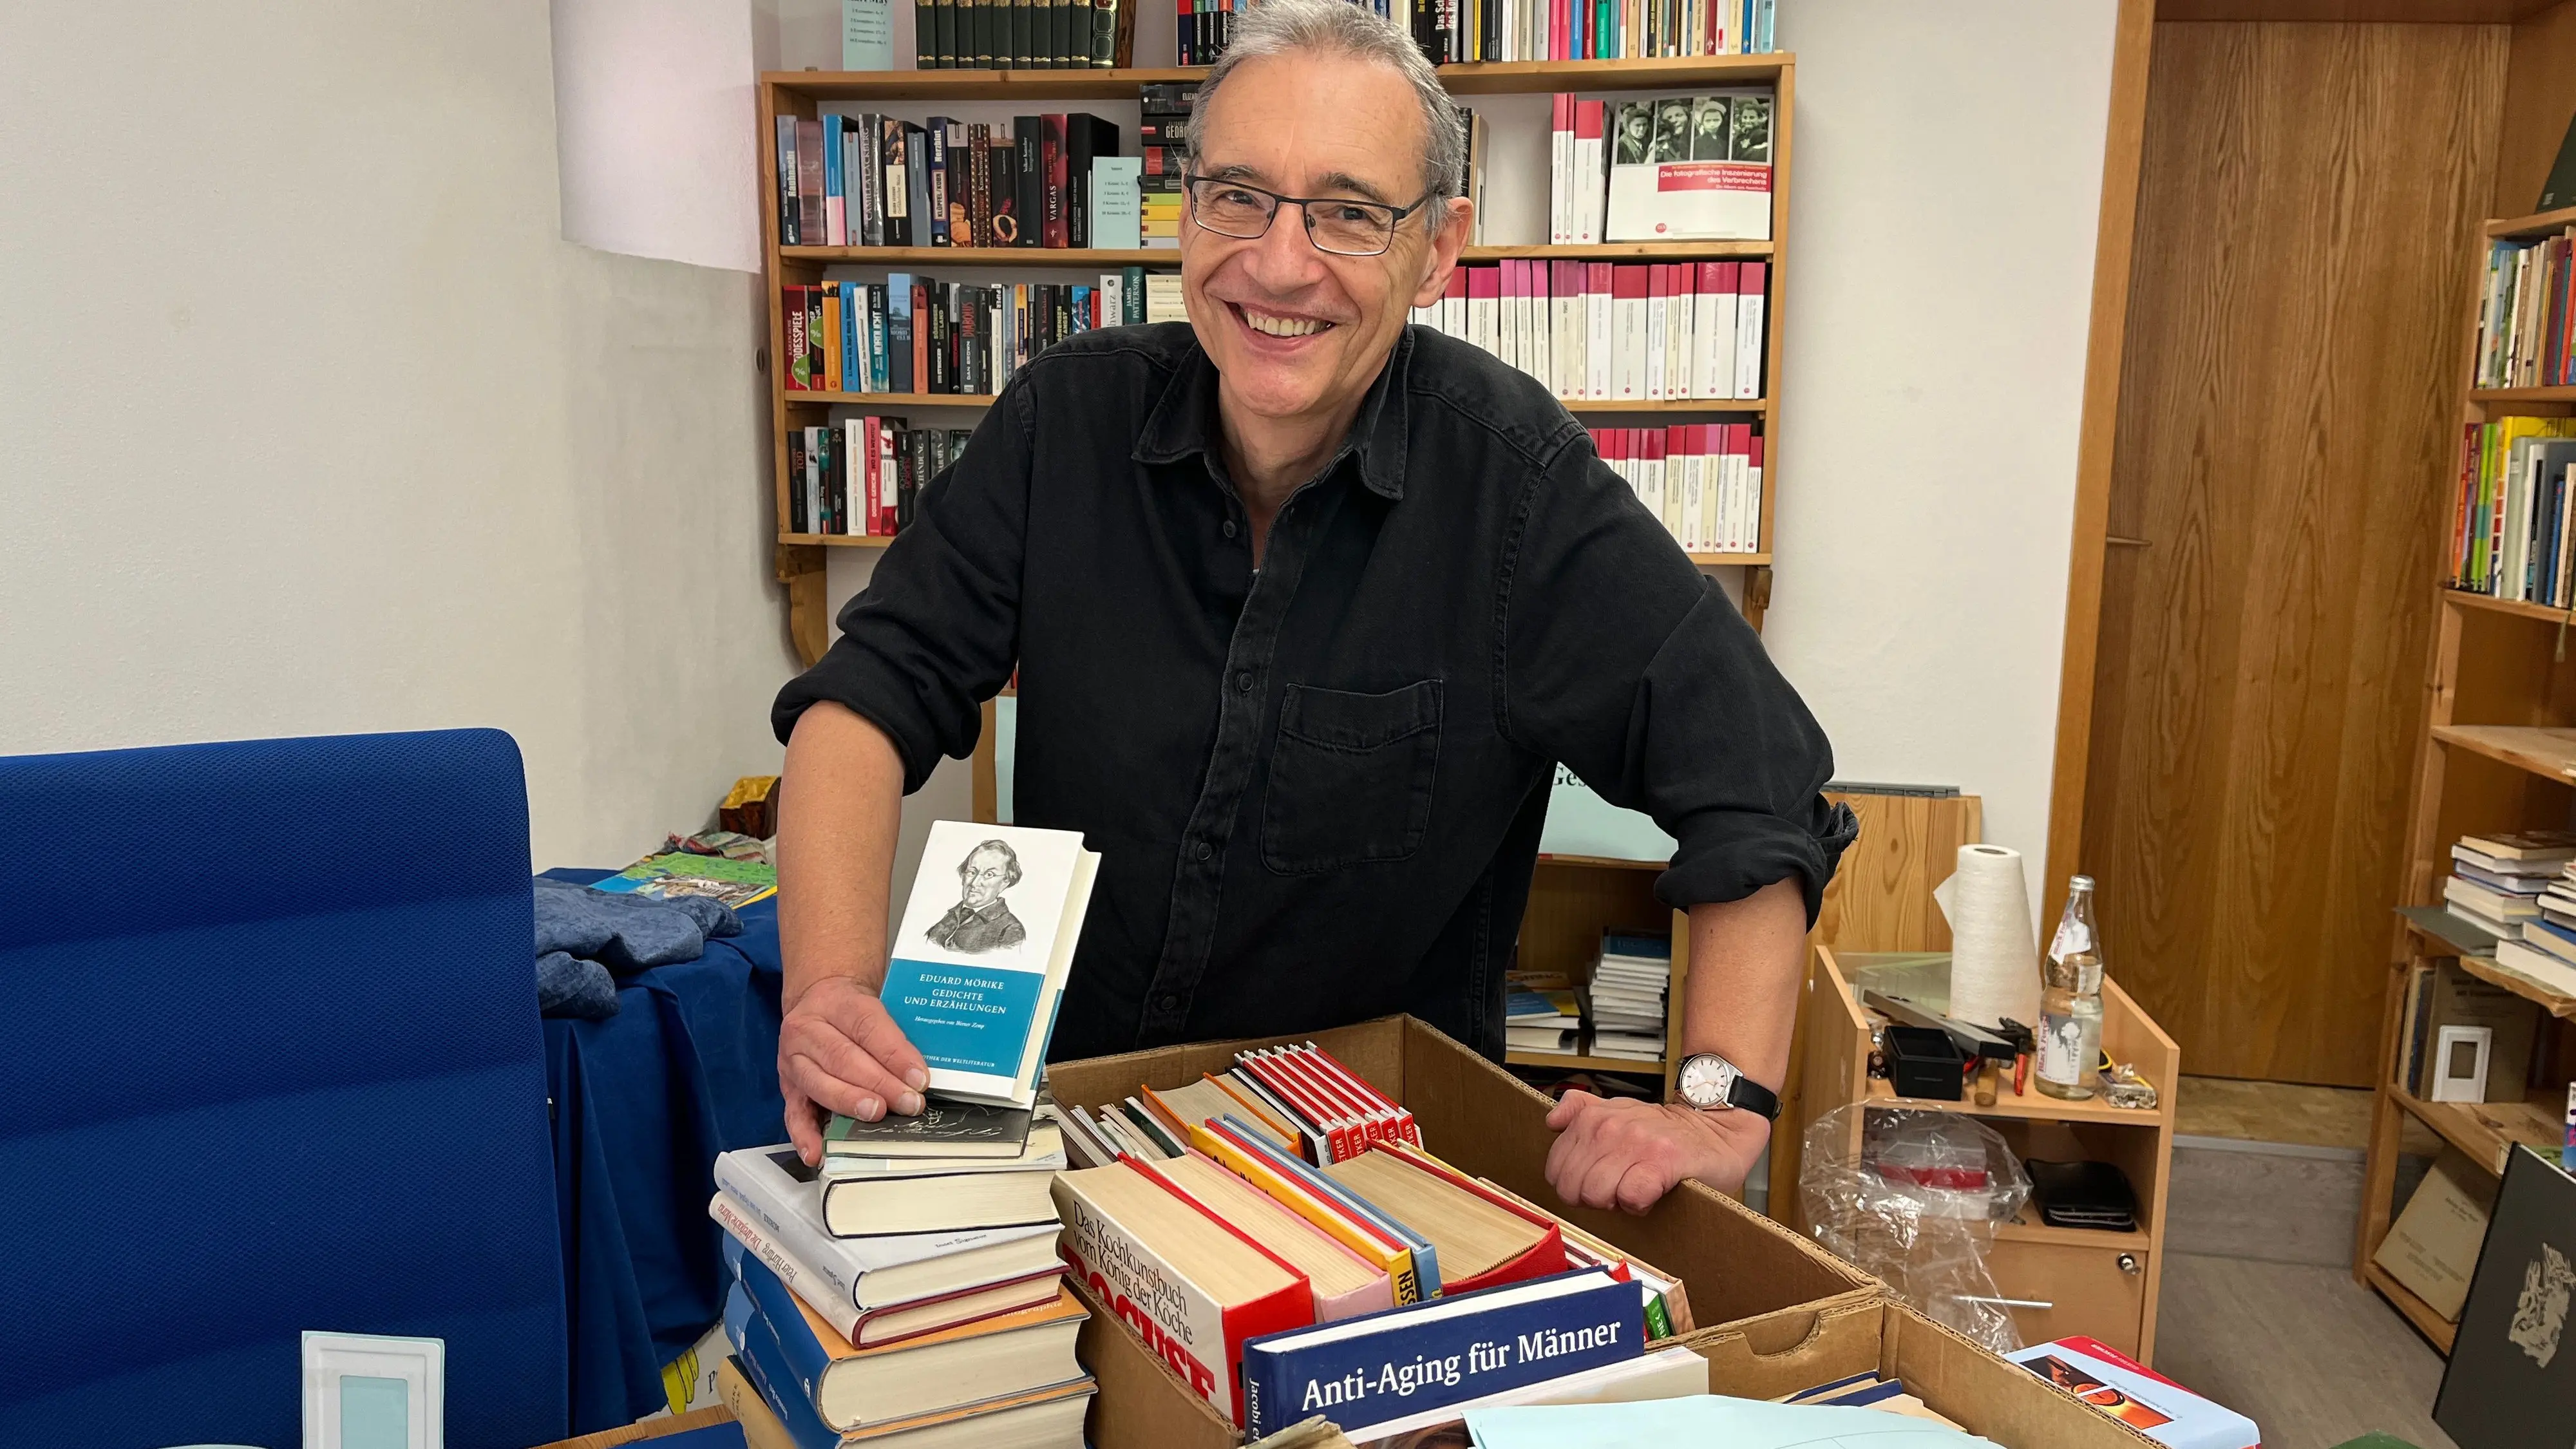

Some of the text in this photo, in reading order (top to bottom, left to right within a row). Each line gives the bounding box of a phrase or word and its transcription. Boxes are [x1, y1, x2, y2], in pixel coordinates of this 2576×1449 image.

[1435, 0, 1445, 30] Das Sc
[1446, 0, 1456, 30] des Ko
[1166, 126, 1188, 138] GEORG
[934, 129, 942, 162] Herzblut
[786, 150, 797, 196] Rauhnacht
[962, 302, 974, 337] DIABOLUS
[873, 311, 883, 355] NORDLICHT
[1553, 766, 1586, 787] Ge
[919, 974, 1005, 990] EDUARD MÖRIKE
[904, 996, 1007, 1014] UND ERZÄHLUNGEN
[932, 989, 984, 1001] GEDICHTE
[914, 1016, 945, 1025] Herausgegeben
[952, 1058, 995, 1067] WELTLITERATUR
[1354, 1133, 1364, 1155] TKER
[1370, 1126, 1379, 1142] KER
[1406, 1123, 1416, 1146] TKER
[1336, 1137, 1347, 1162] ETKER
[717, 1203, 733, 1226] Maria
[729, 1215, 753, 1241] dreifache
[762, 1243, 784, 1271] Härtling
[1074, 1200, 1188, 1317] Das Kochkunstbuch
[781, 1264, 797, 1284] Peter
[1074, 1230, 1193, 1345] vom König der Köche
[1397, 1269, 1416, 1306] SSEN
[1003, 1302, 1062, 1318] ographie
[1302, 1321, 1622, 1413] Anti-Aging für Männer
[1248, 1378, 1260, 1422] Jacobi
